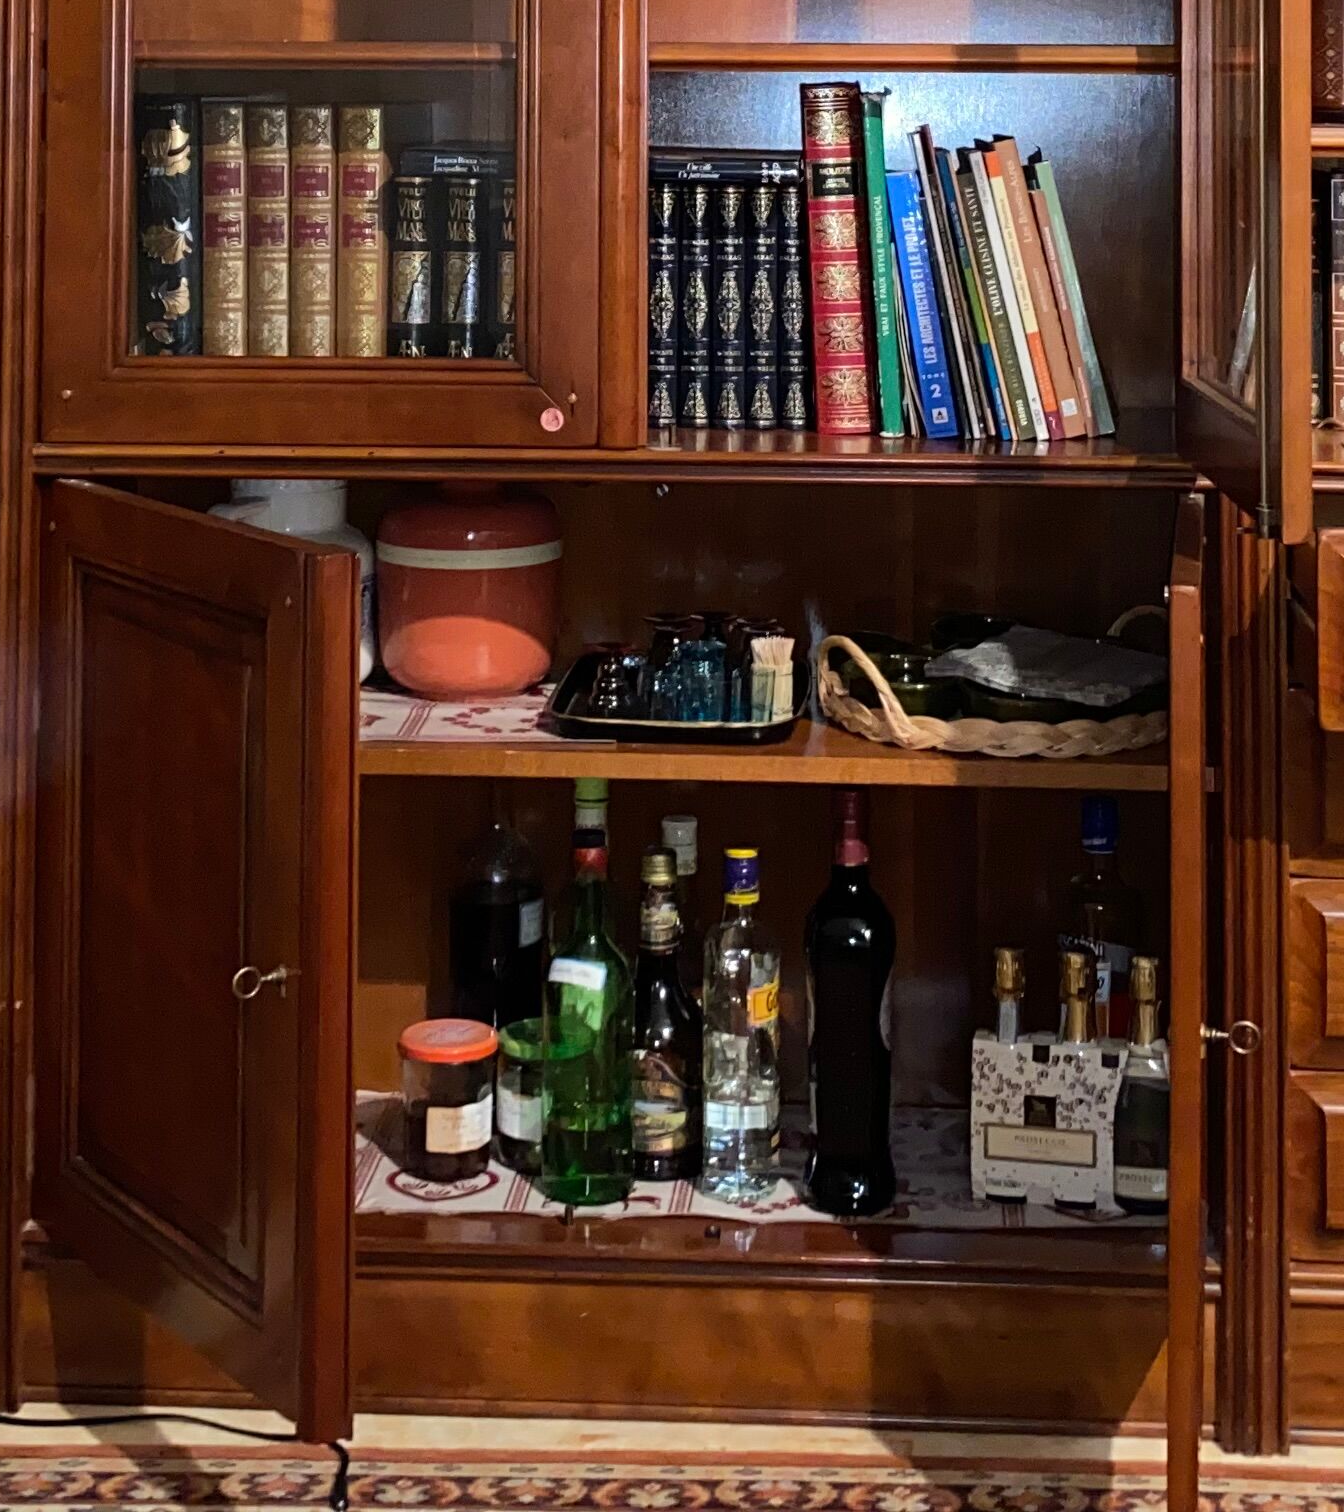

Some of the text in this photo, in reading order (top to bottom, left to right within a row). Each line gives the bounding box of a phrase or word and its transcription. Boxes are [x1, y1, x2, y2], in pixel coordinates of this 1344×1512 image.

[970, 219, 983, 234] ET
[873, 196, 889, 336] VRAI ET FAUX STYLE PROVENÇAL
[976, 234, 994, 276] CUISINE
[902, 216, 937, 364] LES ARCHITECTES ET LE PROJET
[986, 277, 1003, 316] L'OLIVE
[930, 382, 943, 400] 2
[1118, 1172, 1164, 1184] PROSECC
